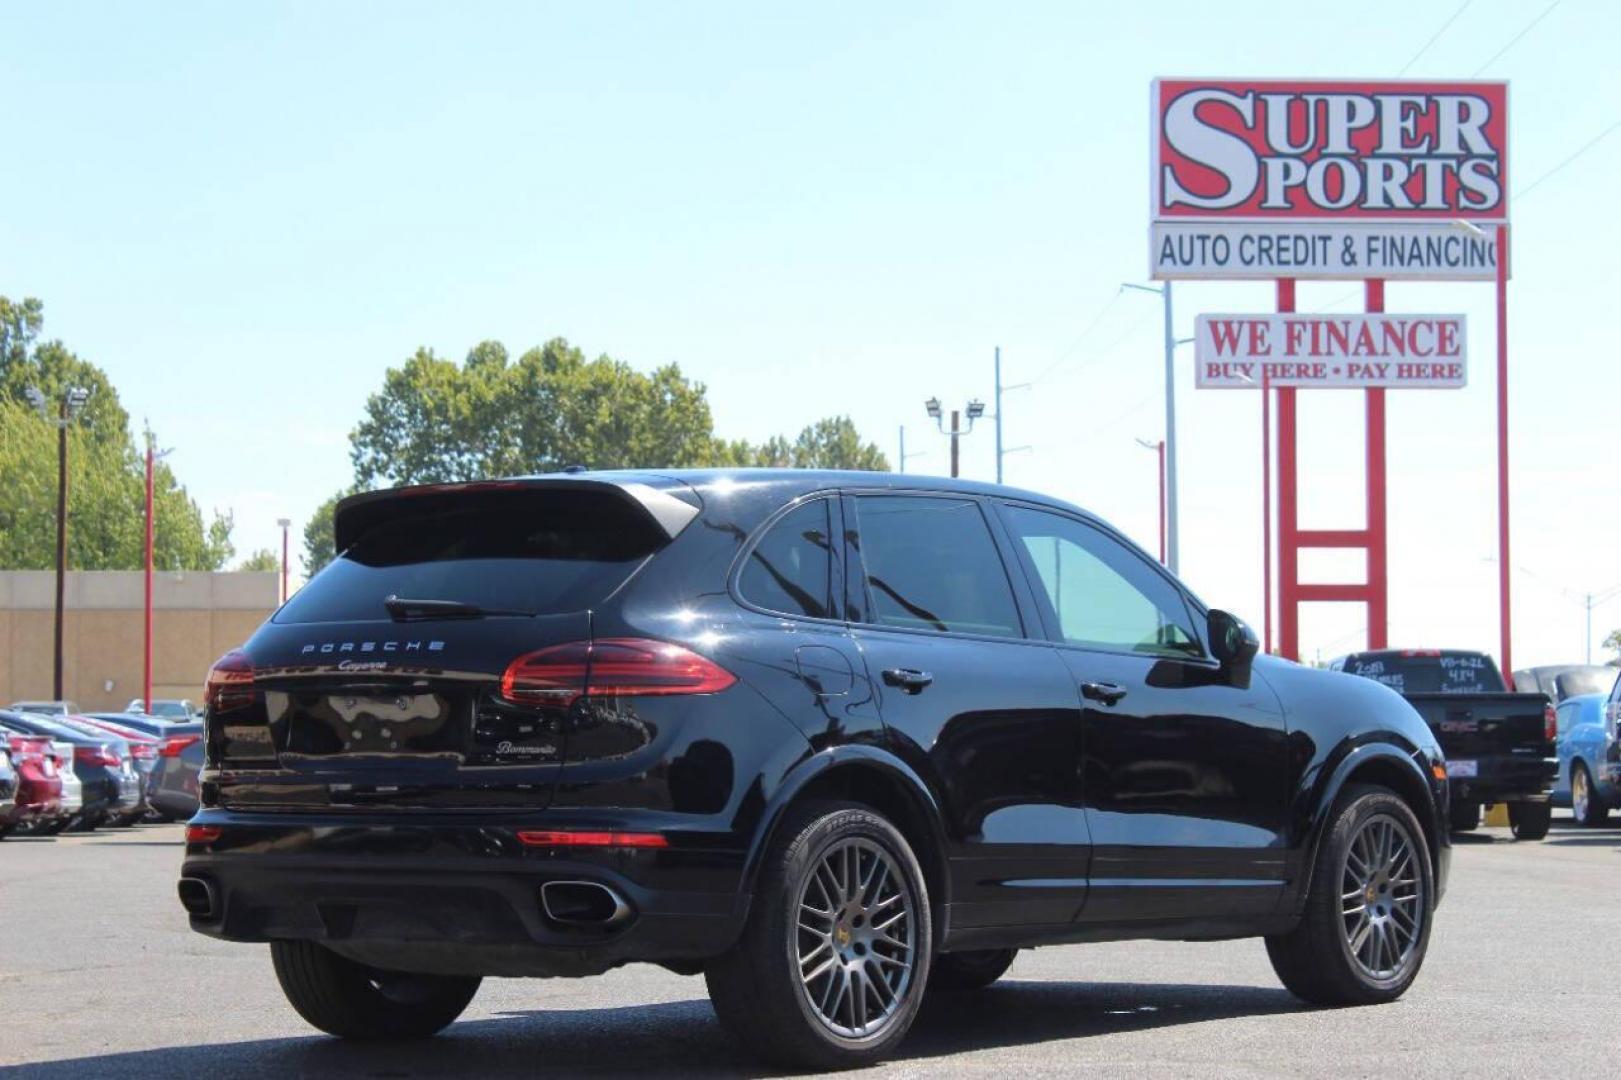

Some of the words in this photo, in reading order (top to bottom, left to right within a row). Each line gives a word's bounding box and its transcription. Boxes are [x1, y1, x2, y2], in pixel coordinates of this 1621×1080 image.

[1164, 87, 1498, 211] SUPER
[1160, 234, 1230, 267] AUTO
[1239, 235, 1332, 267] CREDIT
[1341, 236, 1357, 267] &
[1207, 320, 1272, 357] WE
[1284, 320, 1460, 357] FINANCE
[1207, 362, 1255, 379] BUY
[1263, 362, 1327, 379] HERE
[1347, 362, 1390, 379] PAY
[1397, 363, 1462, 379] HERE
[302, 641, 445, 654] PORSCHE
